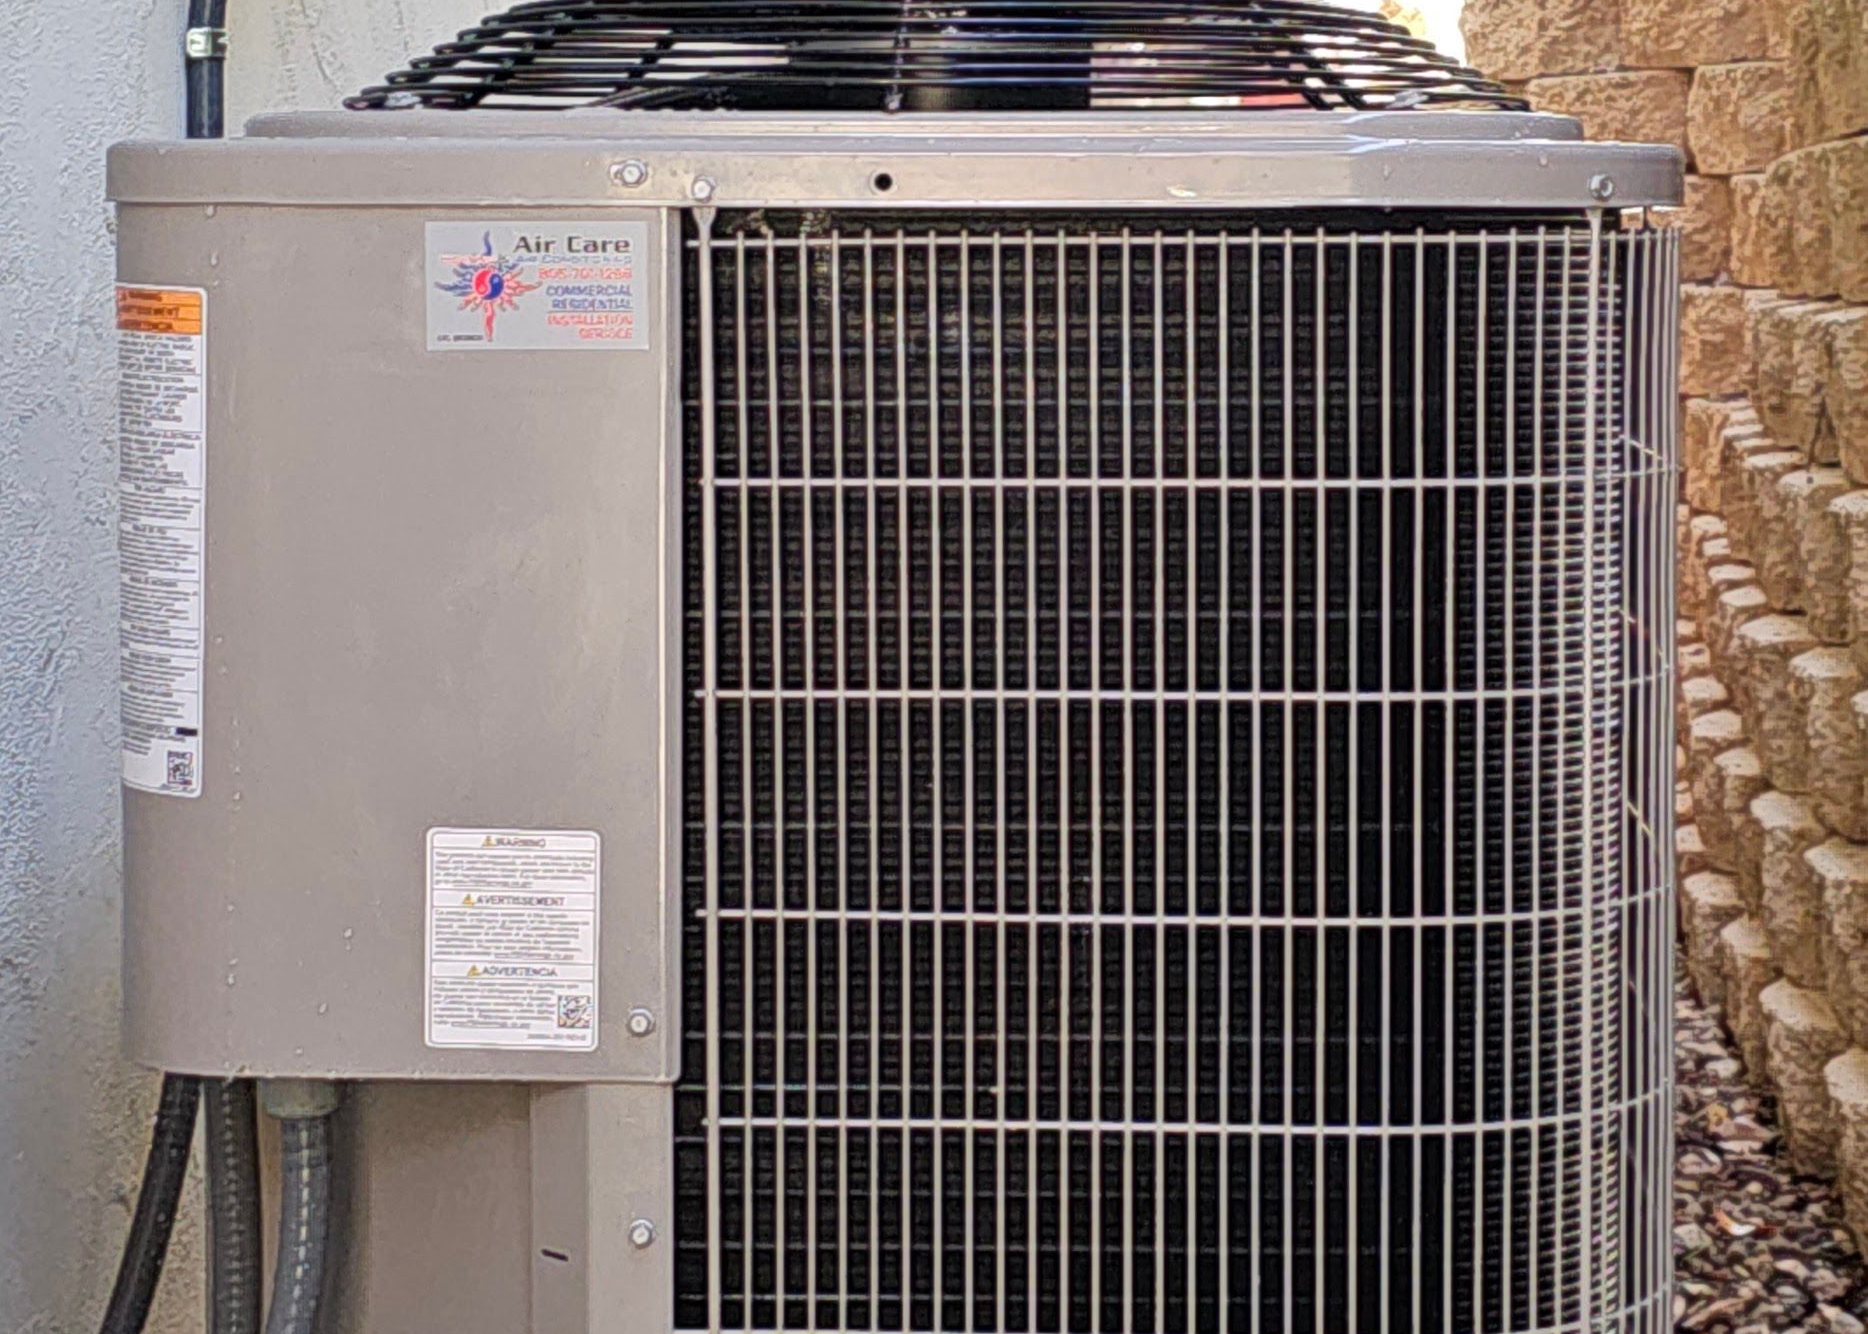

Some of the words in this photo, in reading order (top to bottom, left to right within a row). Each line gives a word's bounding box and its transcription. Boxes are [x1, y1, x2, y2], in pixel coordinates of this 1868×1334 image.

[513, 236, 556, 253] Air
[568, 236, 631, 253] Care
[546, 285, 632, 296] COMMERCIAL
[552, 299, 632, 309] RESIDENTIAL
[547, 315, 632, 326] INSTALLATION
[476, 896, 565, 906] AVERTISSEMENT
[482, 967, 557, 977] ADVERTENCIA
